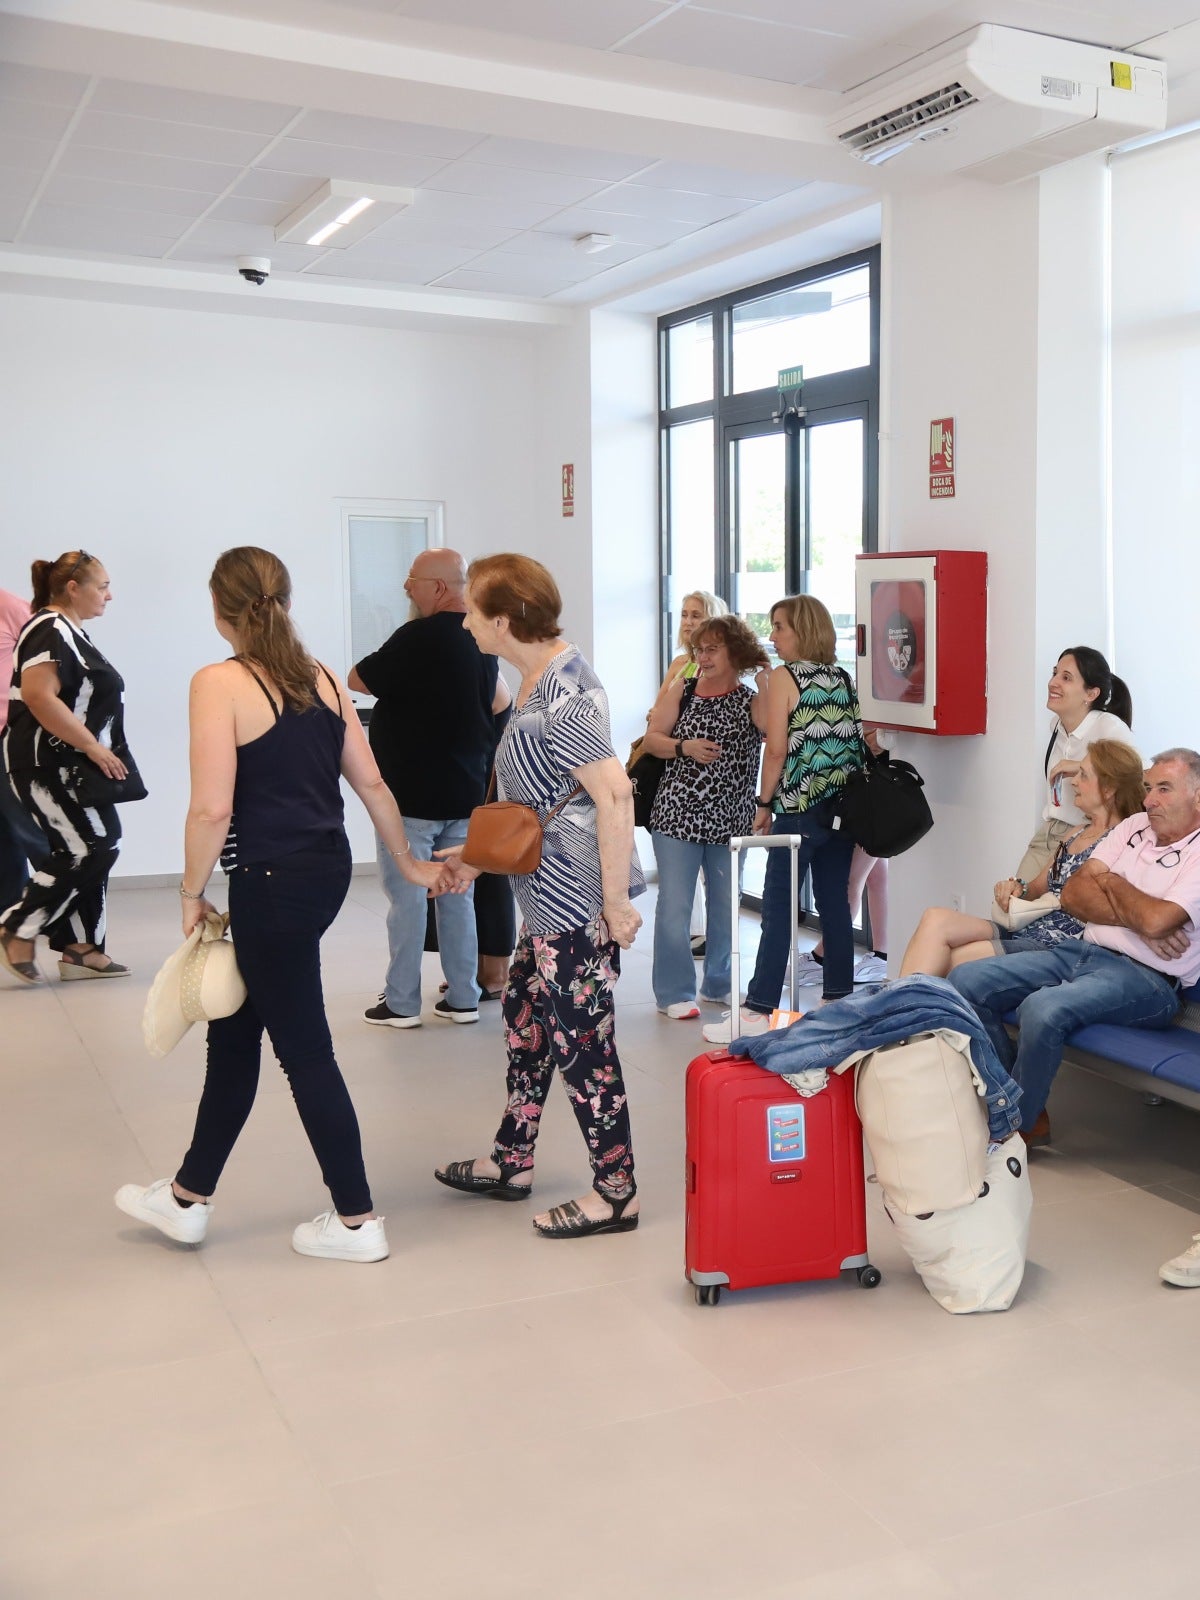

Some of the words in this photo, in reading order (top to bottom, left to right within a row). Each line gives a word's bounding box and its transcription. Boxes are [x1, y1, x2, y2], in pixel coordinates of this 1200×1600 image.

[780, 370, 801, 388] SALIDA
[932, 478, 944, 487] BOCA
[945, 477, 952, 486] DE
[931, 486, 953, 496] INCENDIO
